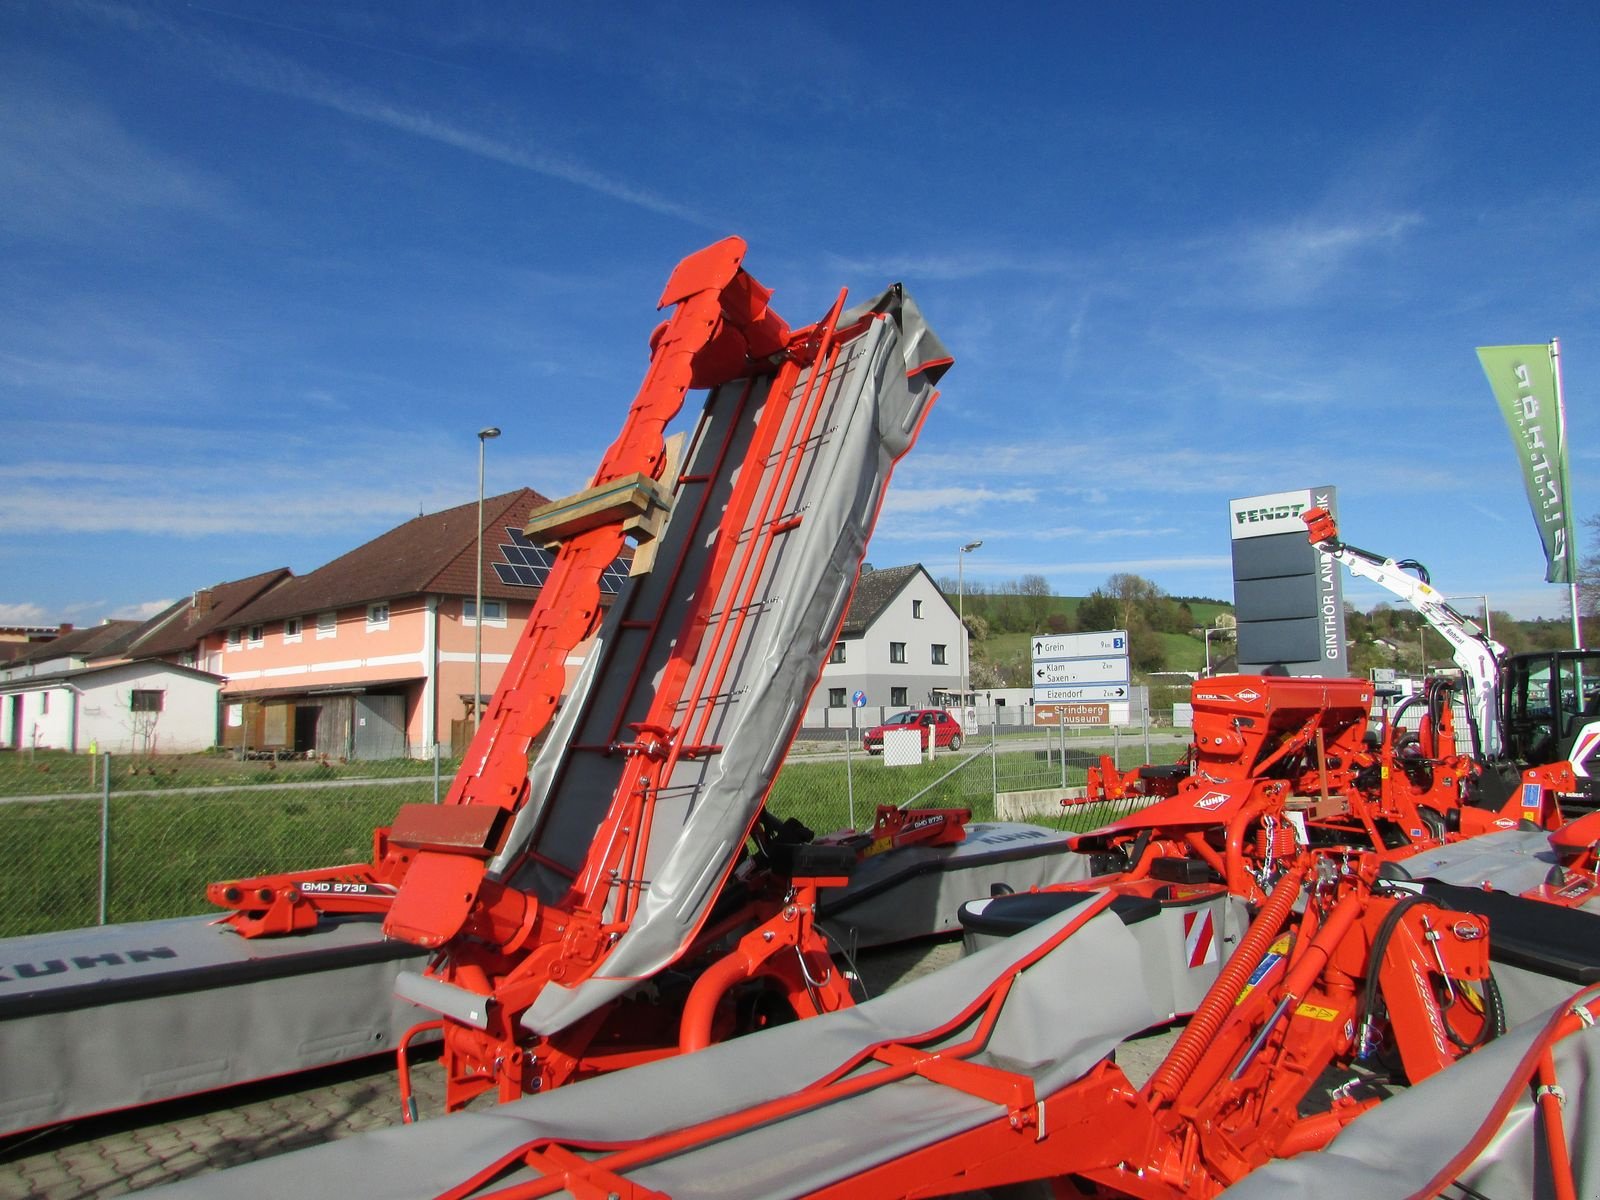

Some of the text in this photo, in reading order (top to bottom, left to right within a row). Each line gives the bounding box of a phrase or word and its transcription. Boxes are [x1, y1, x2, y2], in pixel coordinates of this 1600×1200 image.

[1235, 503, 1305, 525] FENDT
[1321, 595, 1338, 660] GINTHÖR
[1044, 643, 1065, 652] Grein
[1046, 663, 1065, 672] Klam
[1047, 674, 1069, 683] Saxen
[1047, 690, 1083, 699] Eizendorf
[1199, 794, 1225, 808] KUHN
[981, 830, 1048, 845] KUHN
[302, 882, 367, 893] GMD 8730
